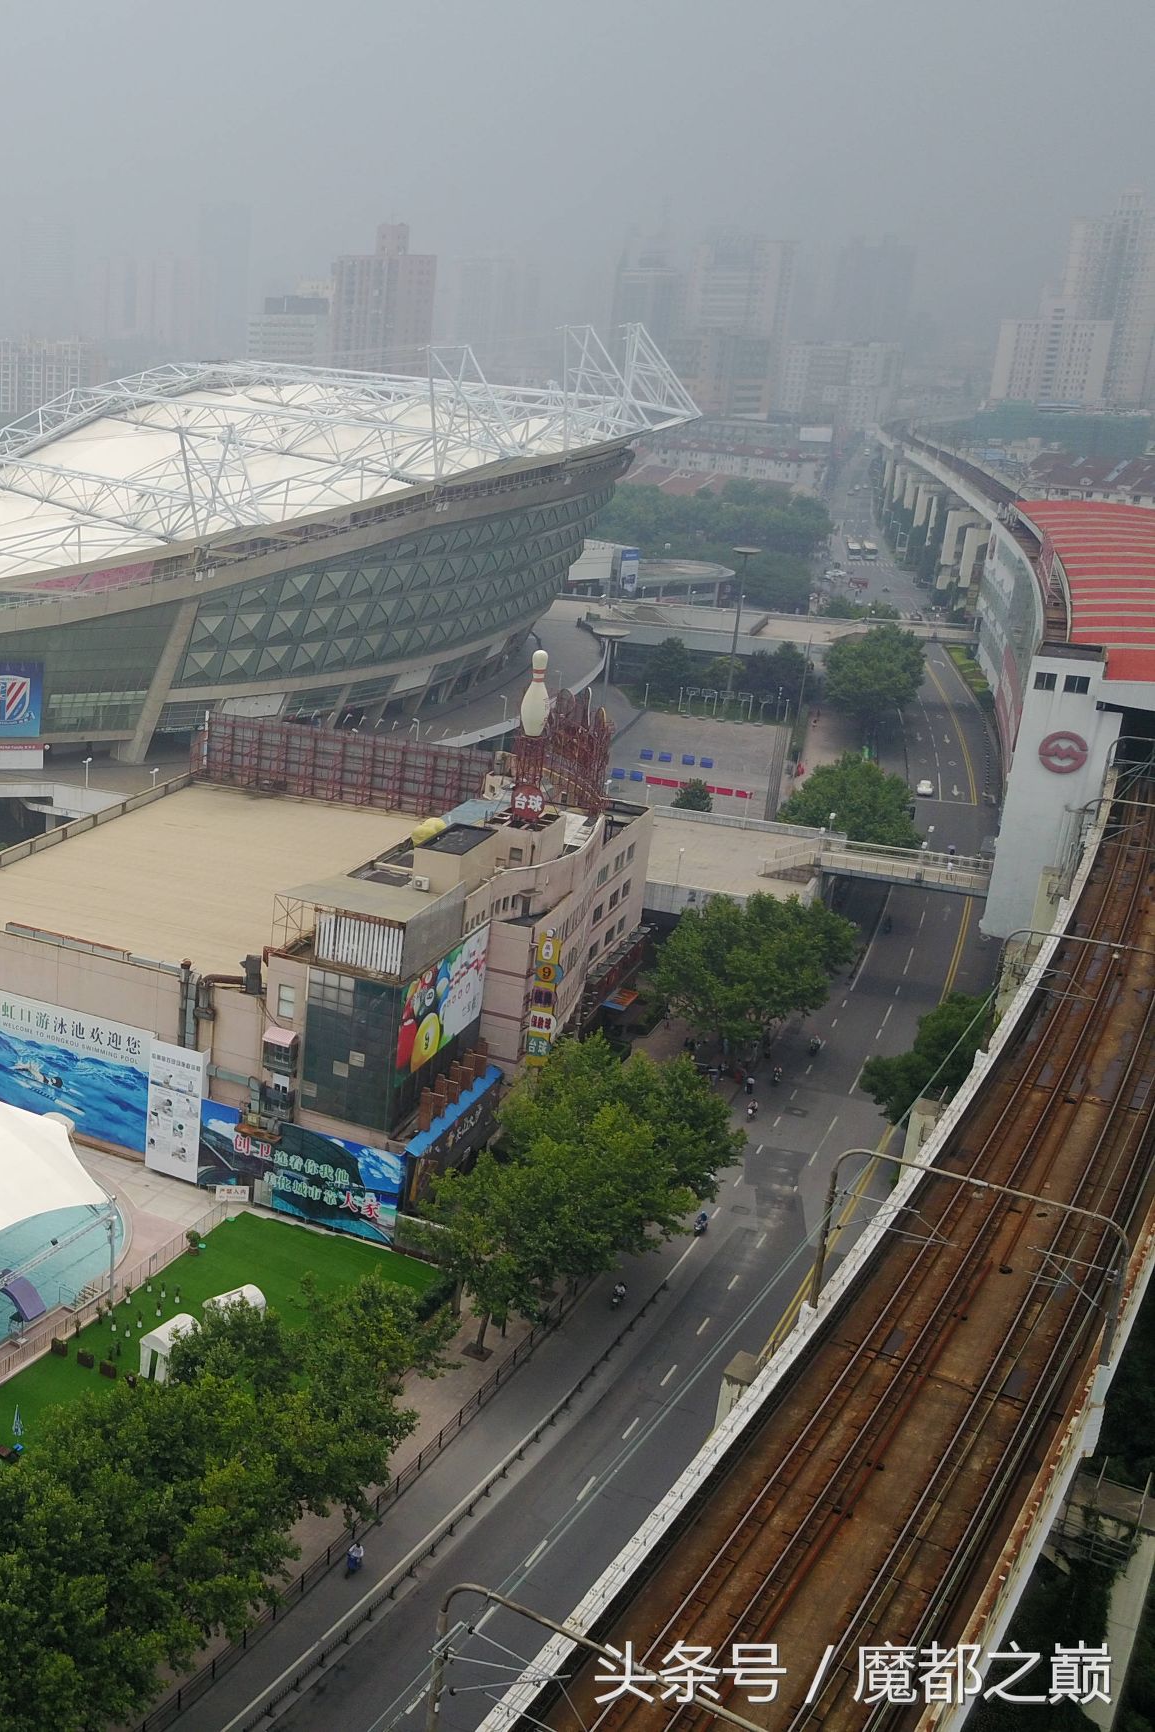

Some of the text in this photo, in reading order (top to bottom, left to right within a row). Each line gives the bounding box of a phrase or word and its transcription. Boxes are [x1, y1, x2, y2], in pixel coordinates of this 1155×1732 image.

[515, 793, 542, 812] 台球
[542, 966, 551, 980] 9
[1, 1001, 141, 1055] 虹口游泳池欢迎您
[2, 1021, 33, 1035] WELCOME
[36, 1030, 44, 1038] TO
[46, 1034, 79, 1048] HONGKOU
[81, 1043, 118, 1059] SWIMMING
[120, 1054, 138, 1065] POOL
[528, 1038, 548, 1056] 台球
